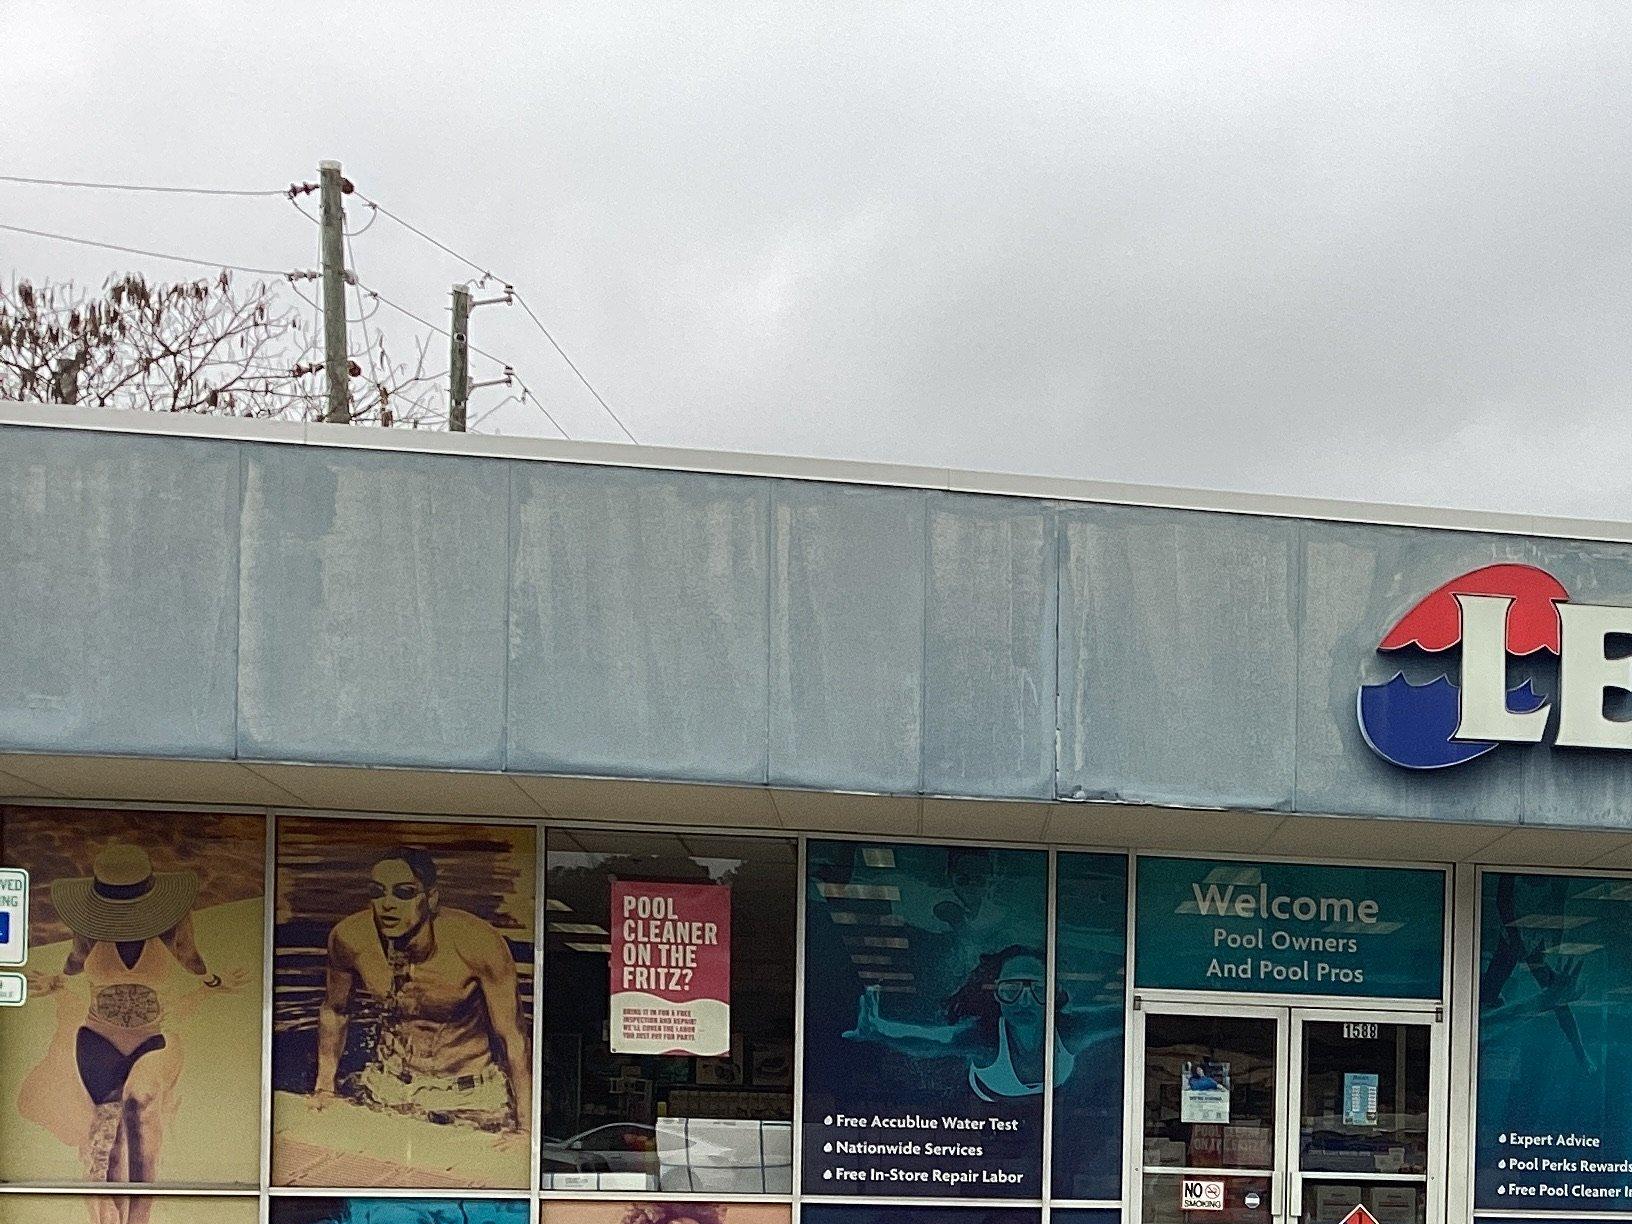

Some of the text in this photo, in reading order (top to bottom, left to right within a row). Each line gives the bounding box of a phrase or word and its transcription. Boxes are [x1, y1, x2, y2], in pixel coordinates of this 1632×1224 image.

[623, 895, 678, 920] POOL
[1192, 882, 1379, 924] Welcome
[623, 919, 718, 945] CLEANER
[1214, 928, 1358, 953] Pool Owners
[623, 943, 697, 968] ON THE
[623, 966, 693, 991] FRITZ?
[1206, 958, 1364, 984] And Pool Pros
[836, 1114, 1019, 1131] Free Accublue Water Test
[836, 1141, 983, 1156] Nationwide Services
[1510, 1133, 1600, 1148] Expert Advice
[1509, 1158, 1539, 1171] Pool
[1542, 1159, 1577, 1172] Perks
[836, 1168, 1024, 1185] Free In-Store Repair Labor
[1184, 1183, 1203, 1198] NO
[1508, 1183, 1536, 1196] Free
[1539, 1184, 1568, 1197] Pool
[1572, 1185, 1621, 1198] Cleaner
[1184, 1200, 1222, 1208] SMOKING
